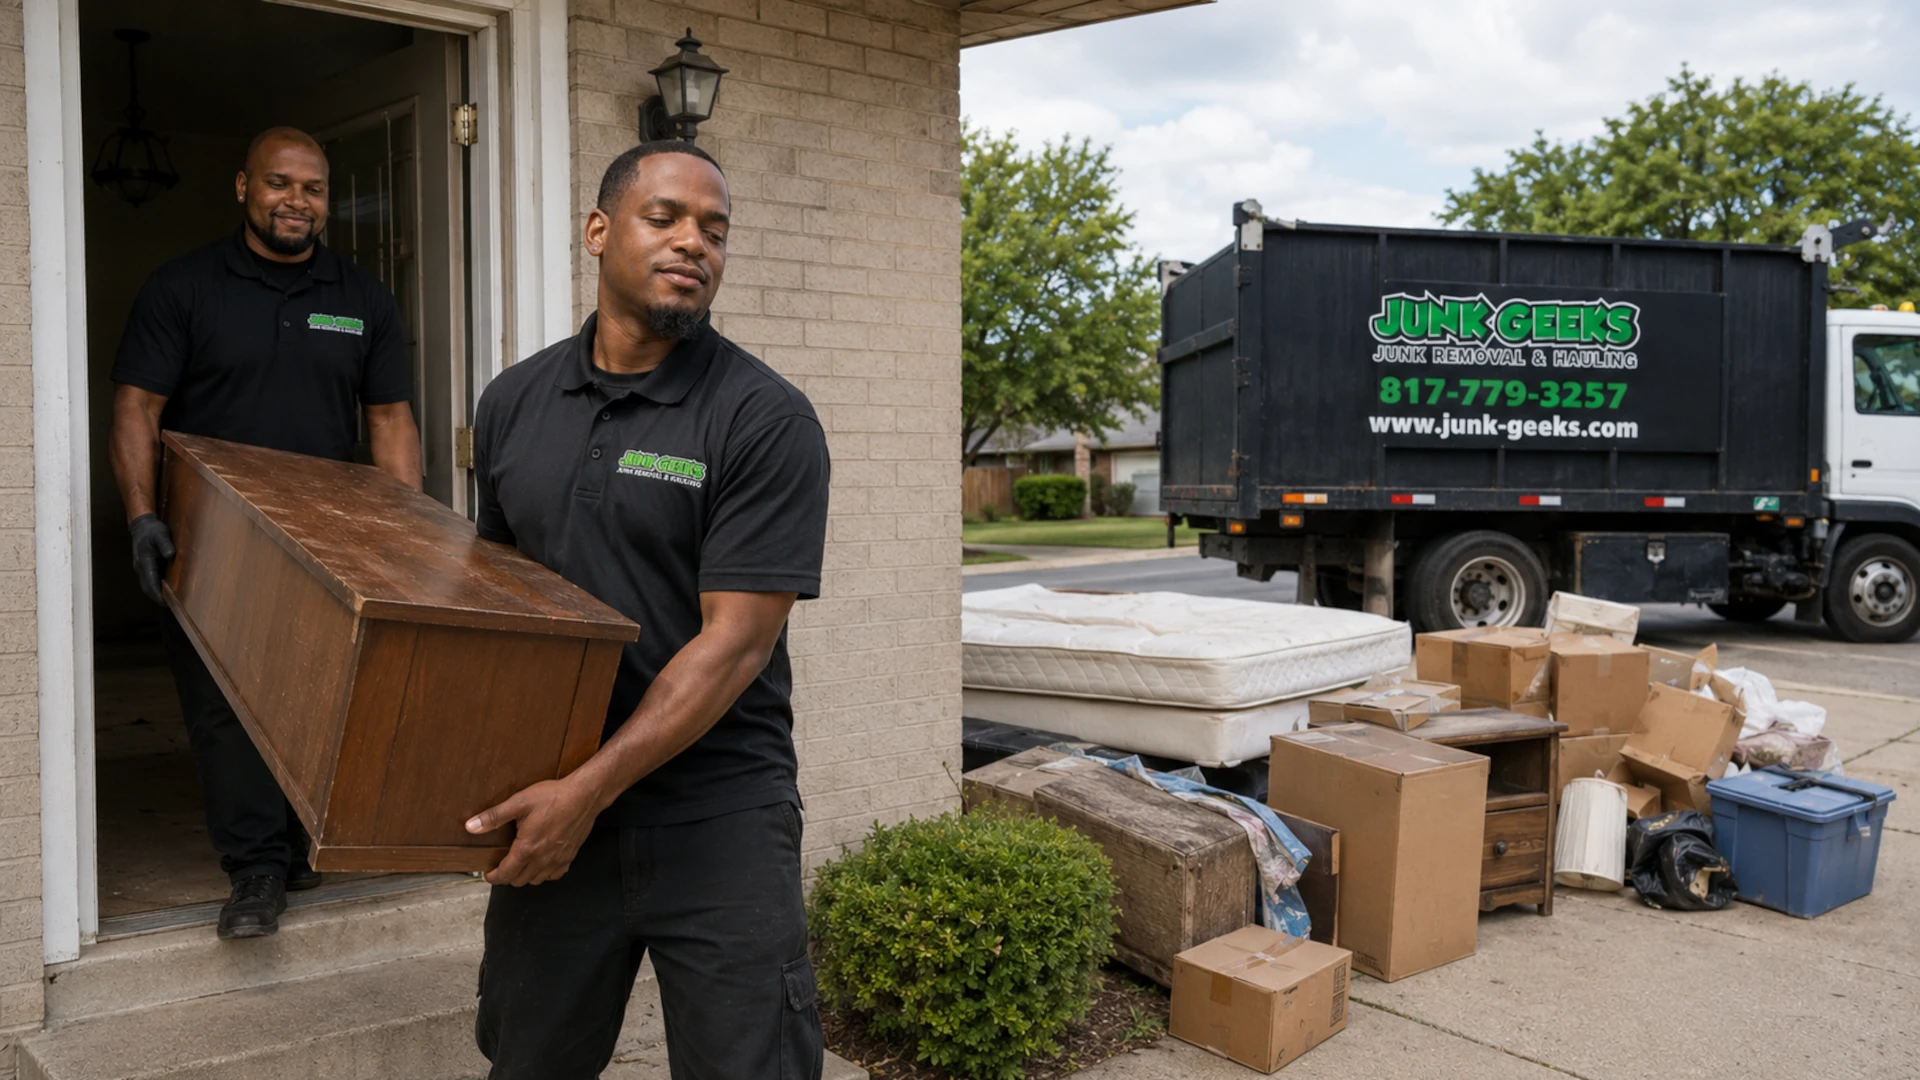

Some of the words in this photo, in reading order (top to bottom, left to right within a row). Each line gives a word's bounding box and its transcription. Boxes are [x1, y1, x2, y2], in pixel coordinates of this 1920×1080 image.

[1371, 293, 1493, 344] JUNK
[1496, 300, 1637, 347] GEEKS
[1372, 345, 1427, 363] JUNK
[1432, 347, 1526, 366] REMOVAL
[1531, 349, 1547, 367] &
[1553, 350, 1638, 369] HAULING
[1379, 376, 1628, 409] 817-779-3257
[1368, 412, 1638, 440] www.junk-geeks.com
